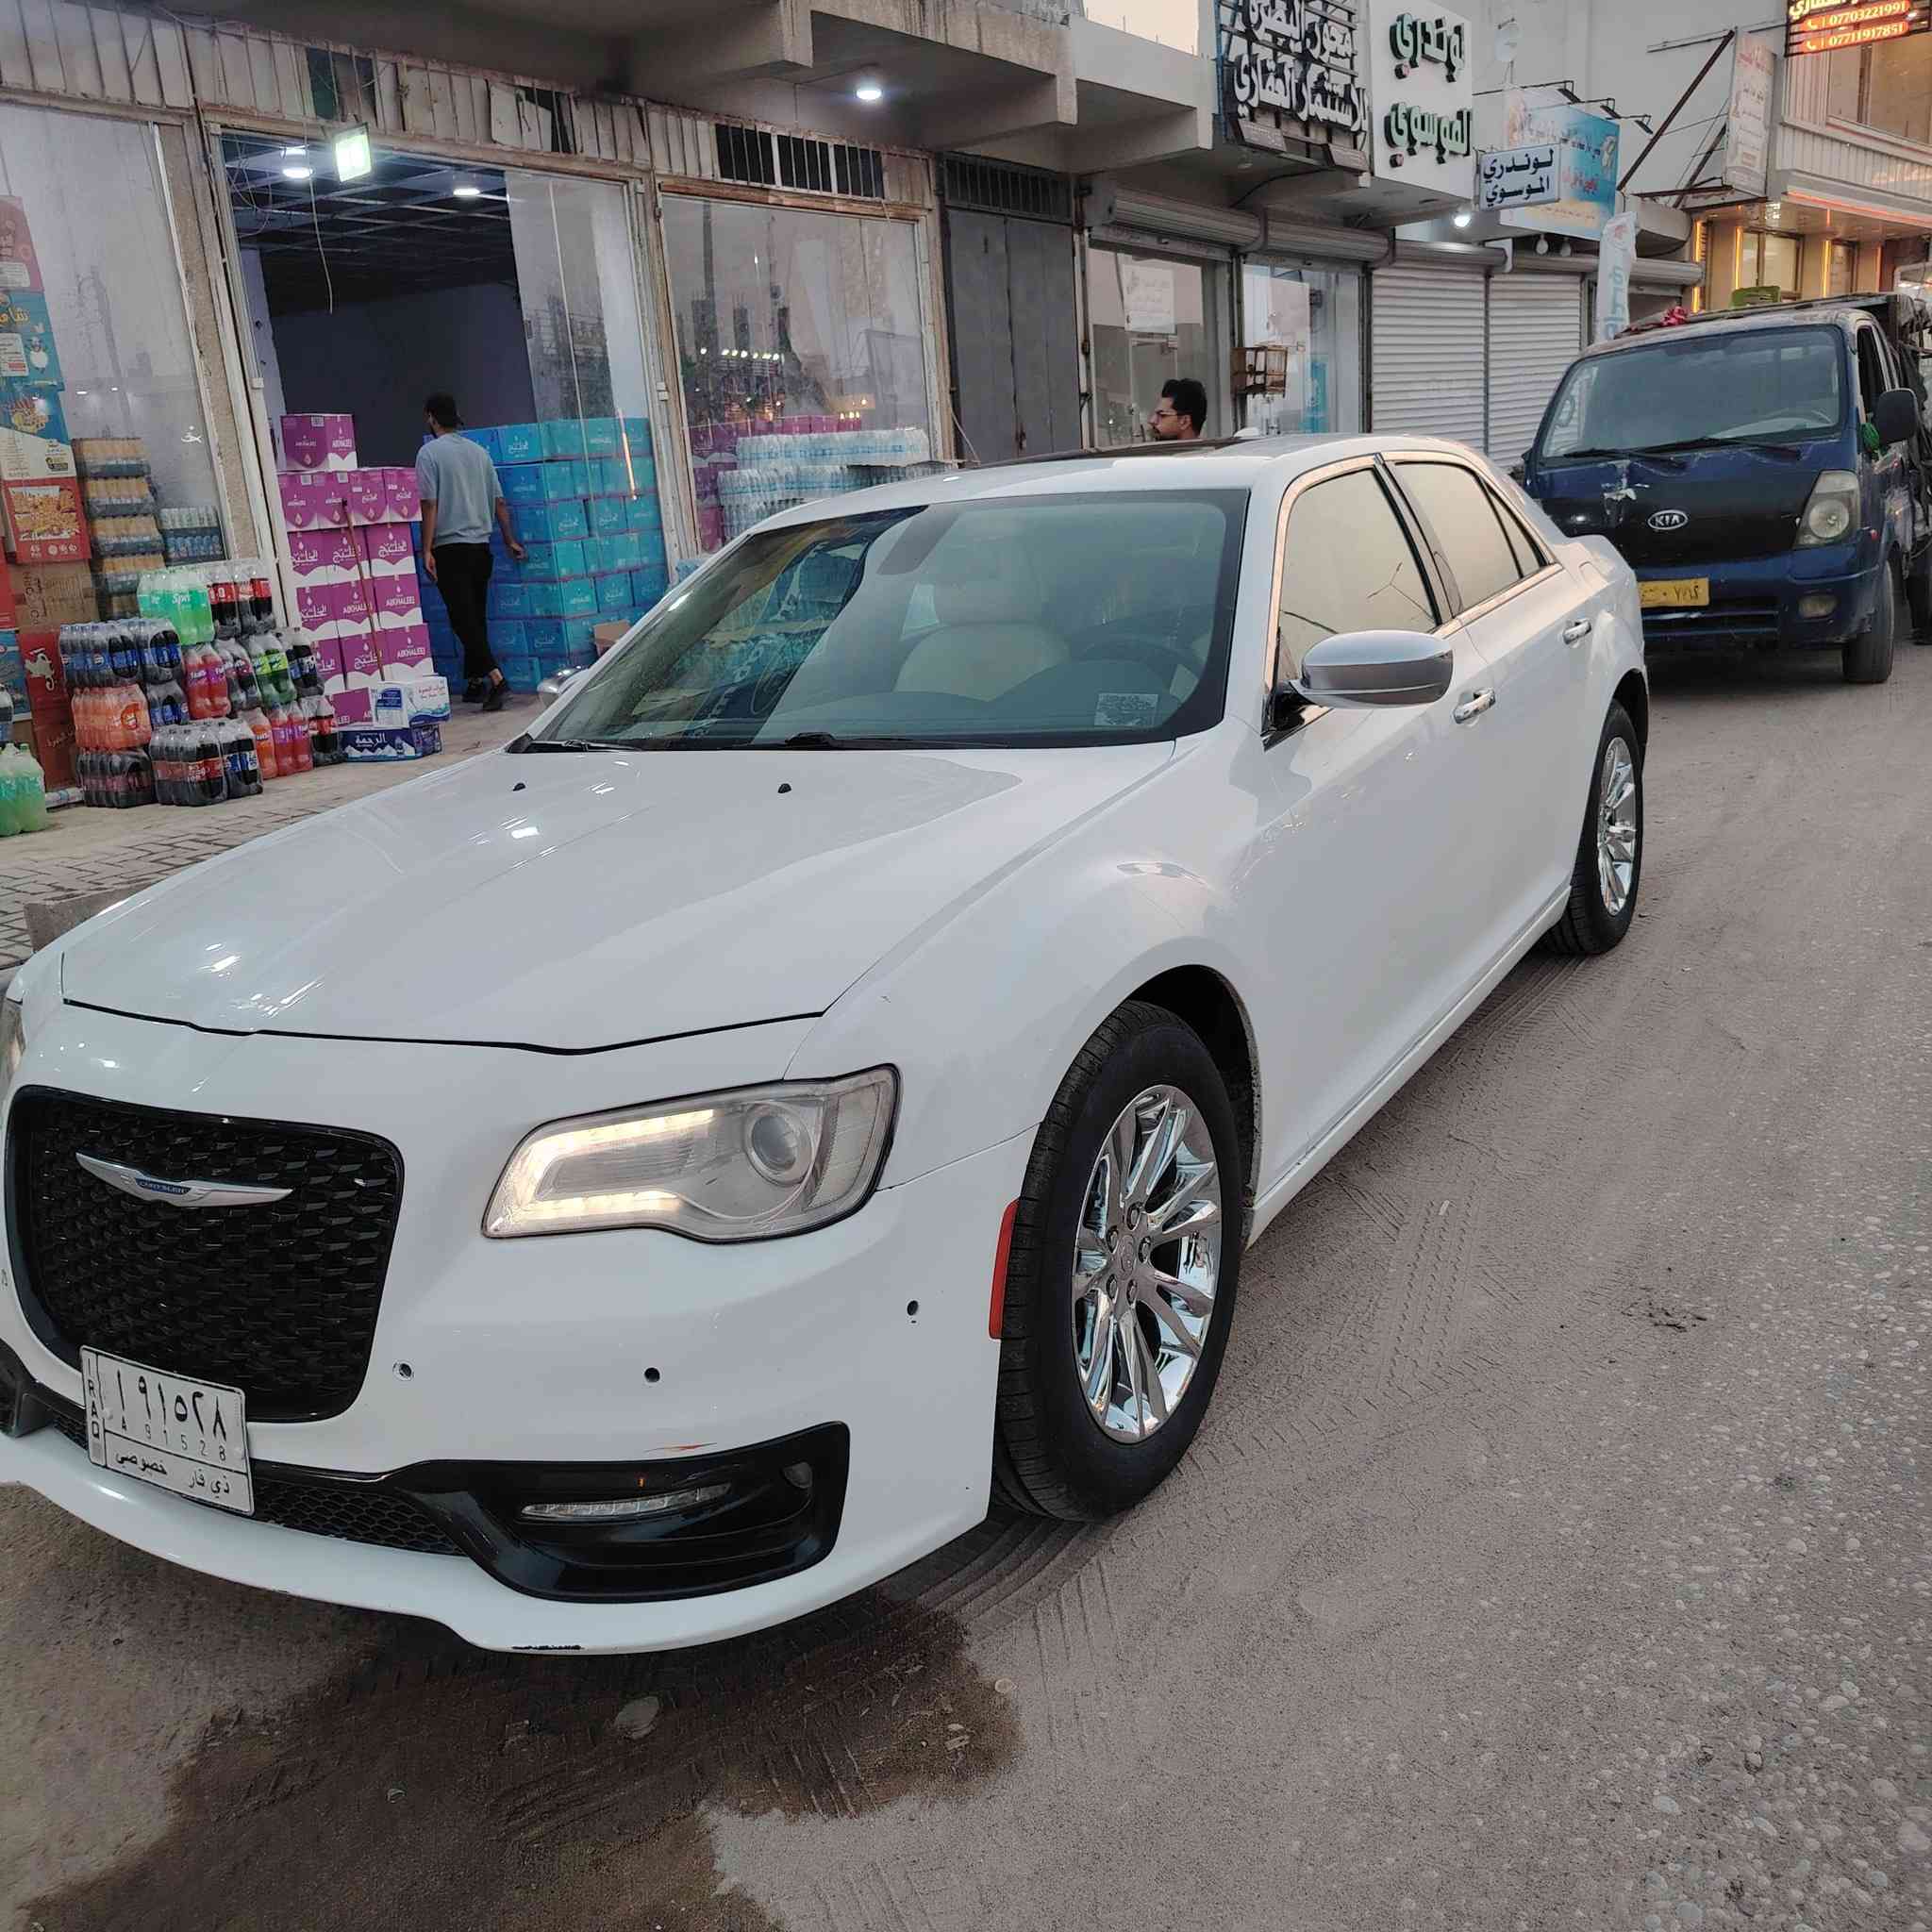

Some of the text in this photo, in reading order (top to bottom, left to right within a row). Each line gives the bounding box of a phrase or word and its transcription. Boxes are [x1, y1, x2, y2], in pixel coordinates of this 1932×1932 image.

[1828, 2, 1907, 25] 07703221991
[1390, 12, 1465, 83] لوندري
[1384, 102, 1471, 169] الموسوي
[1483, 148, 1555, 183] لوندري
[1486, 175, 1550, 208] الموسوي
[1655, 514, 1680, 526] KIA
[115, 1452, 168, 1476] خصوصي
[209, 1474, 231, 1498] ذي
